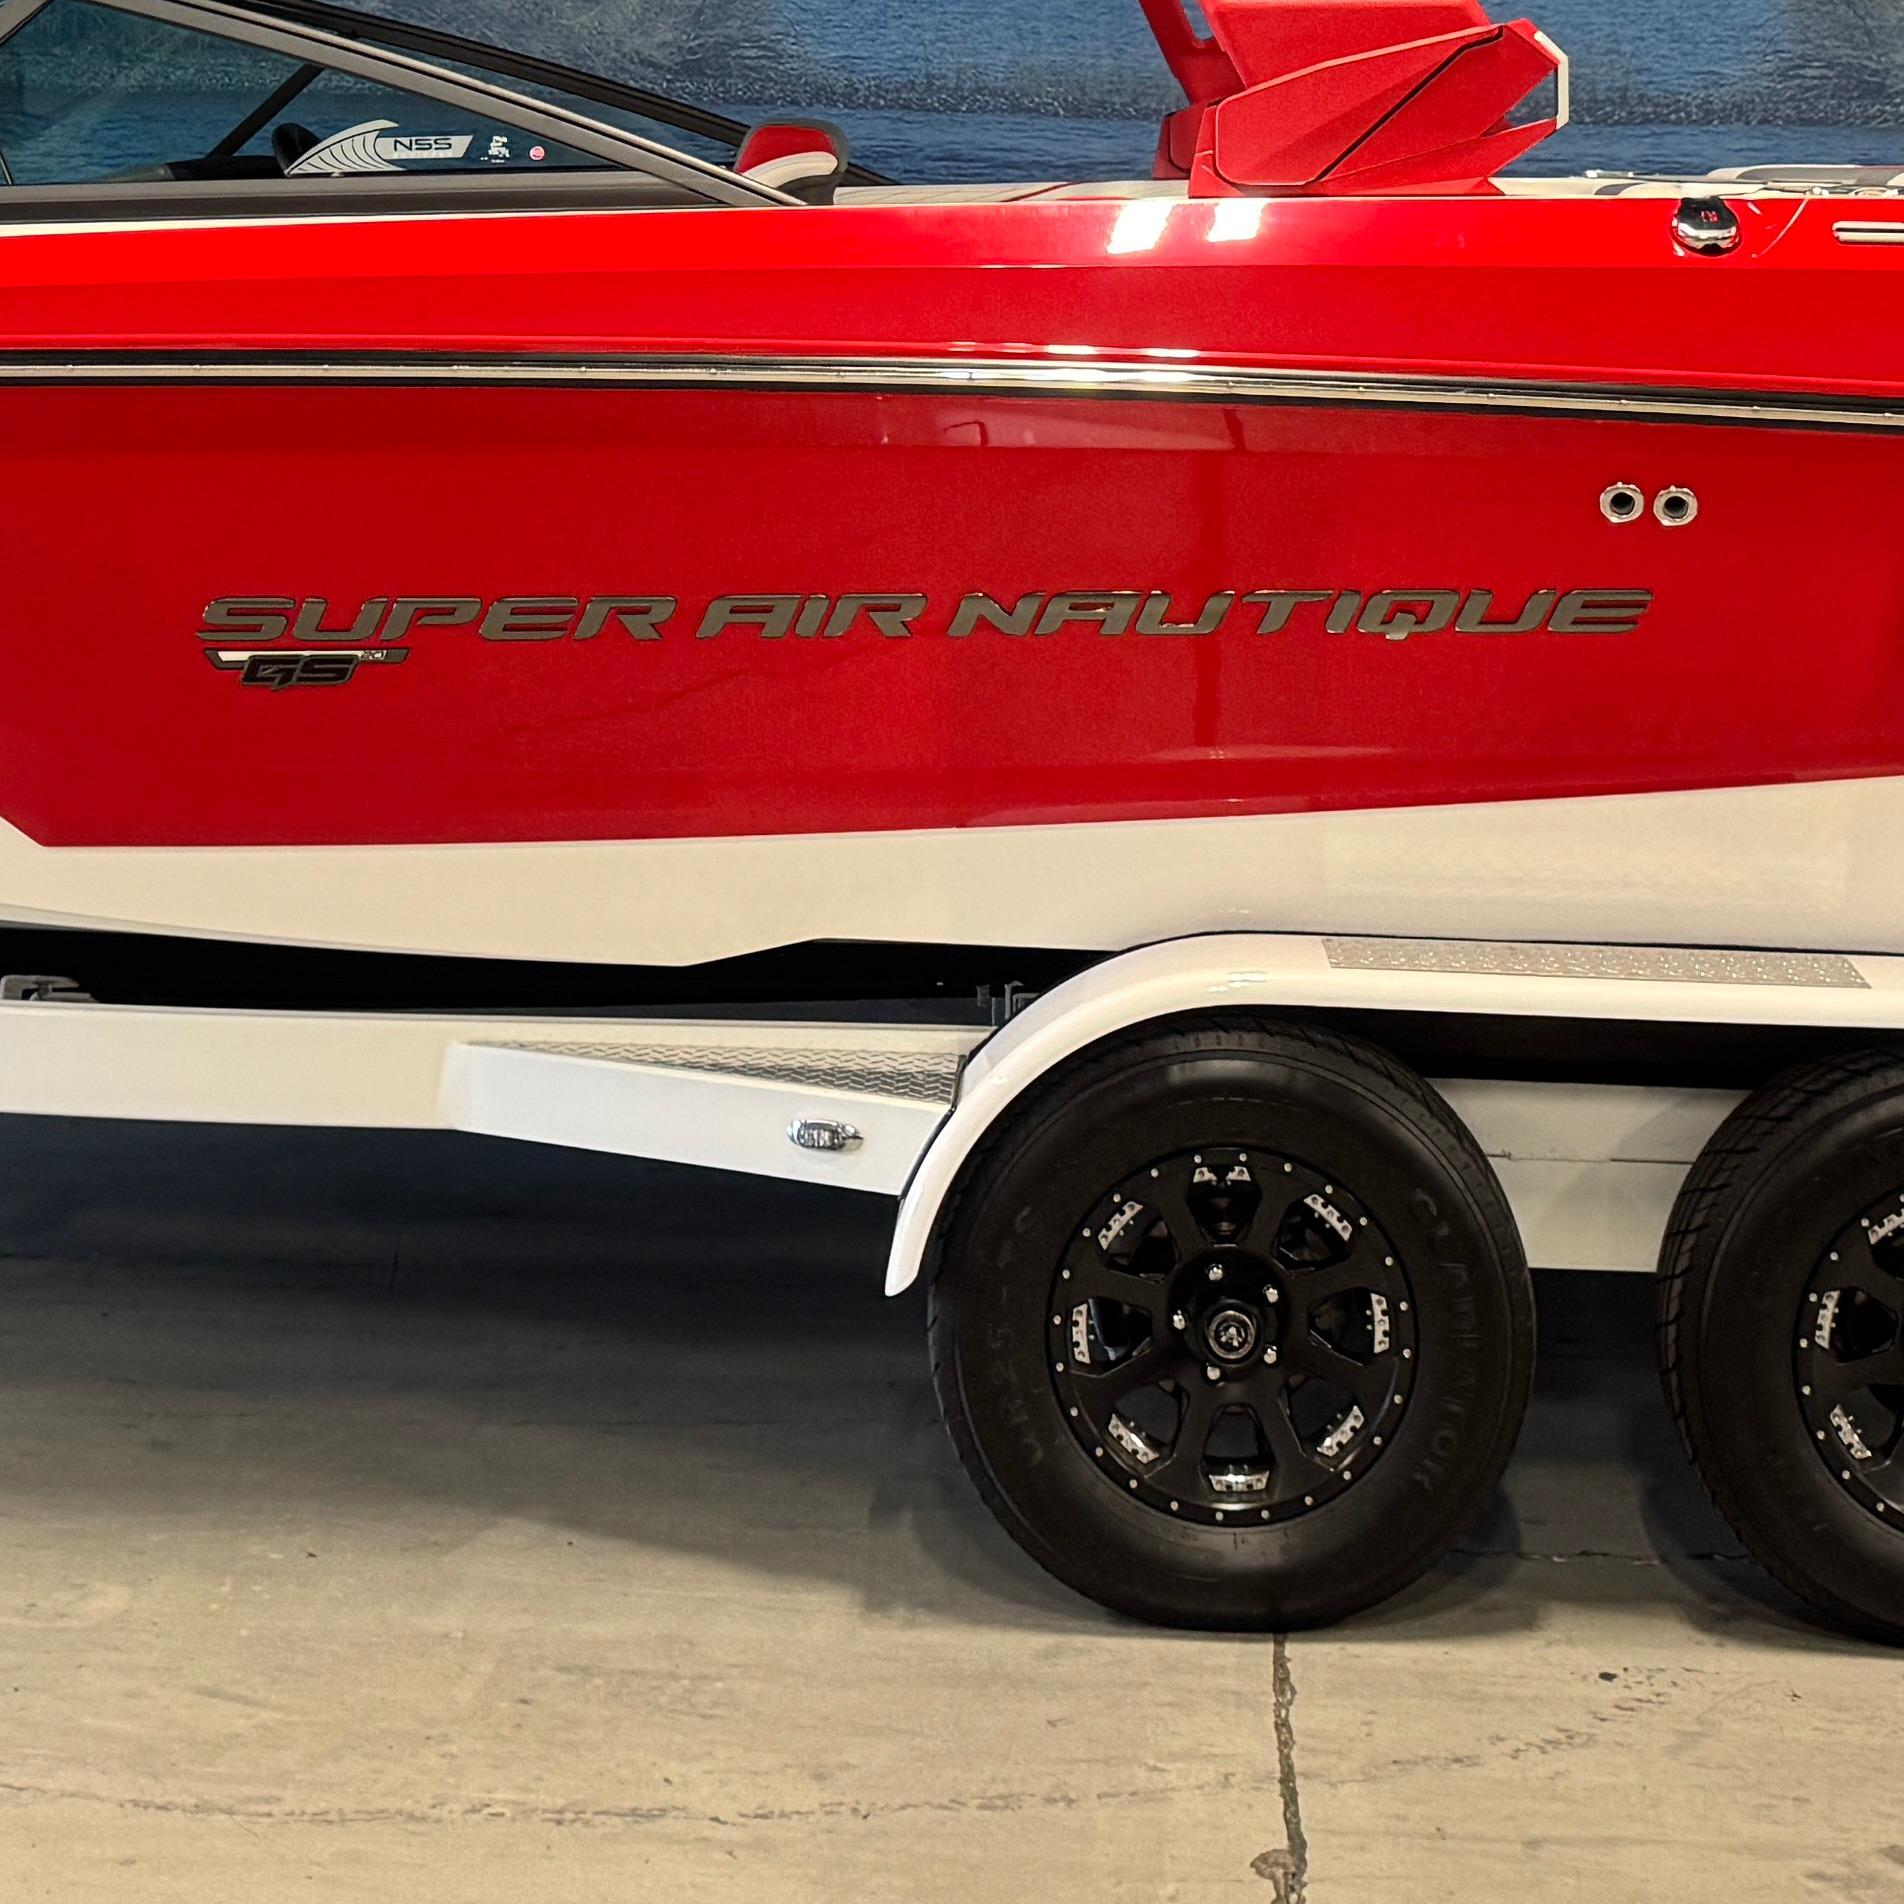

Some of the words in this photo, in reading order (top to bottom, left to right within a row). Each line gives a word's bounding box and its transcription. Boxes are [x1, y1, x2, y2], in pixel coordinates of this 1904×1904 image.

[393, 137, 453, 152] NSS
[194, 595, 679, 642] SUPER
[696, 590, 928, 639] AIR
[946, 586, 1656, 642] NAUTIQUE
